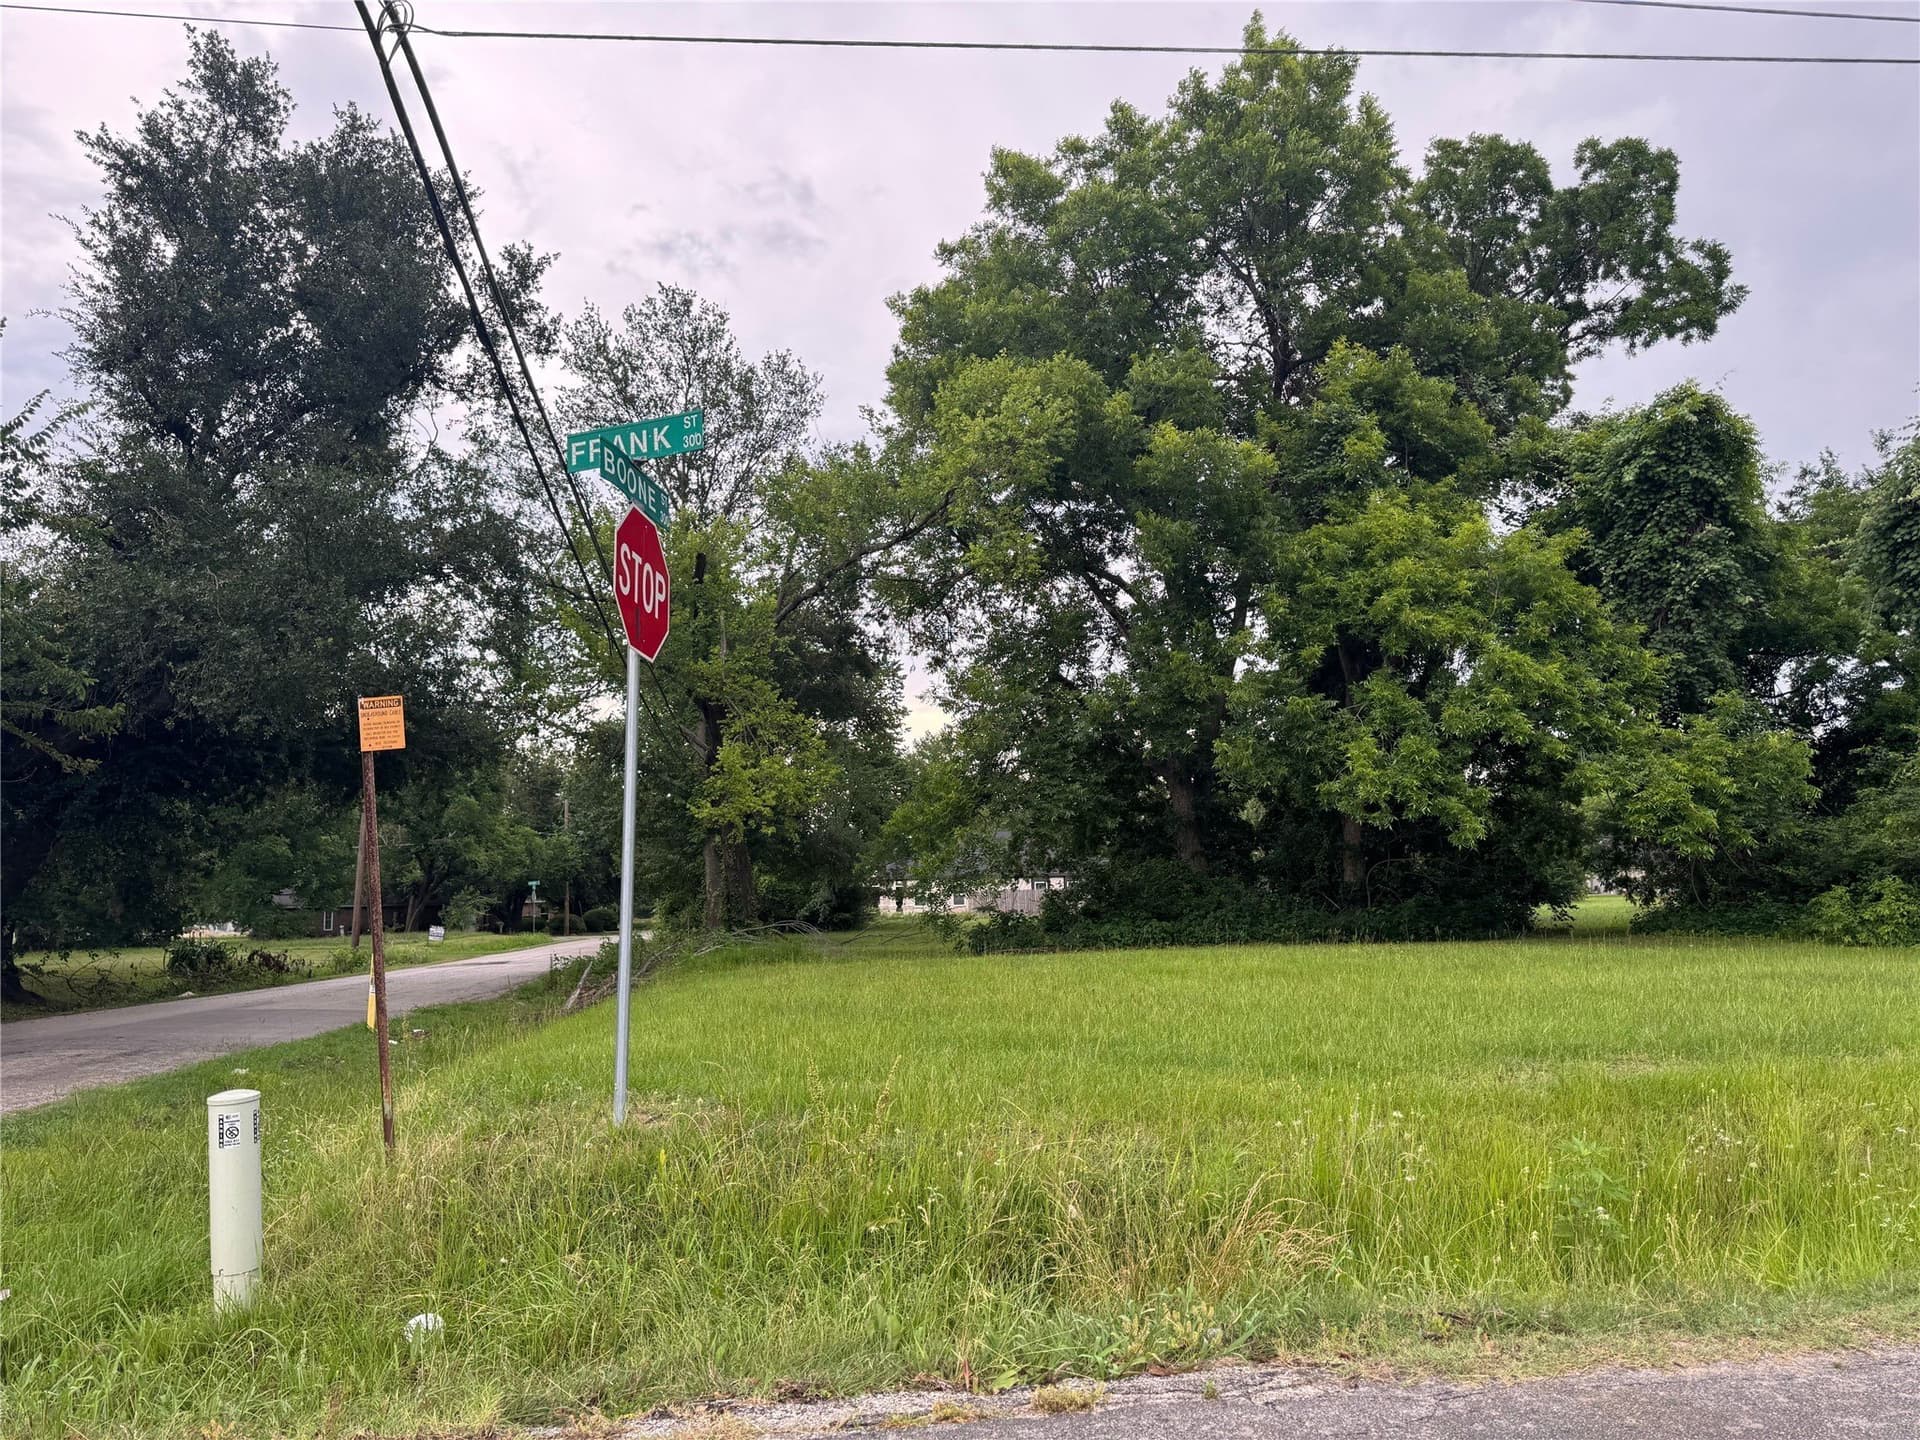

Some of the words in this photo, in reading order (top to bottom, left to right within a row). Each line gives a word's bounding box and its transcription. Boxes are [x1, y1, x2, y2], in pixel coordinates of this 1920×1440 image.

[682, 432, 702, 449] 300
[683, 414, 698, 429] ST
[603, 446, 657, 513] BOONE
[619, 542, 666, 619] STOP
